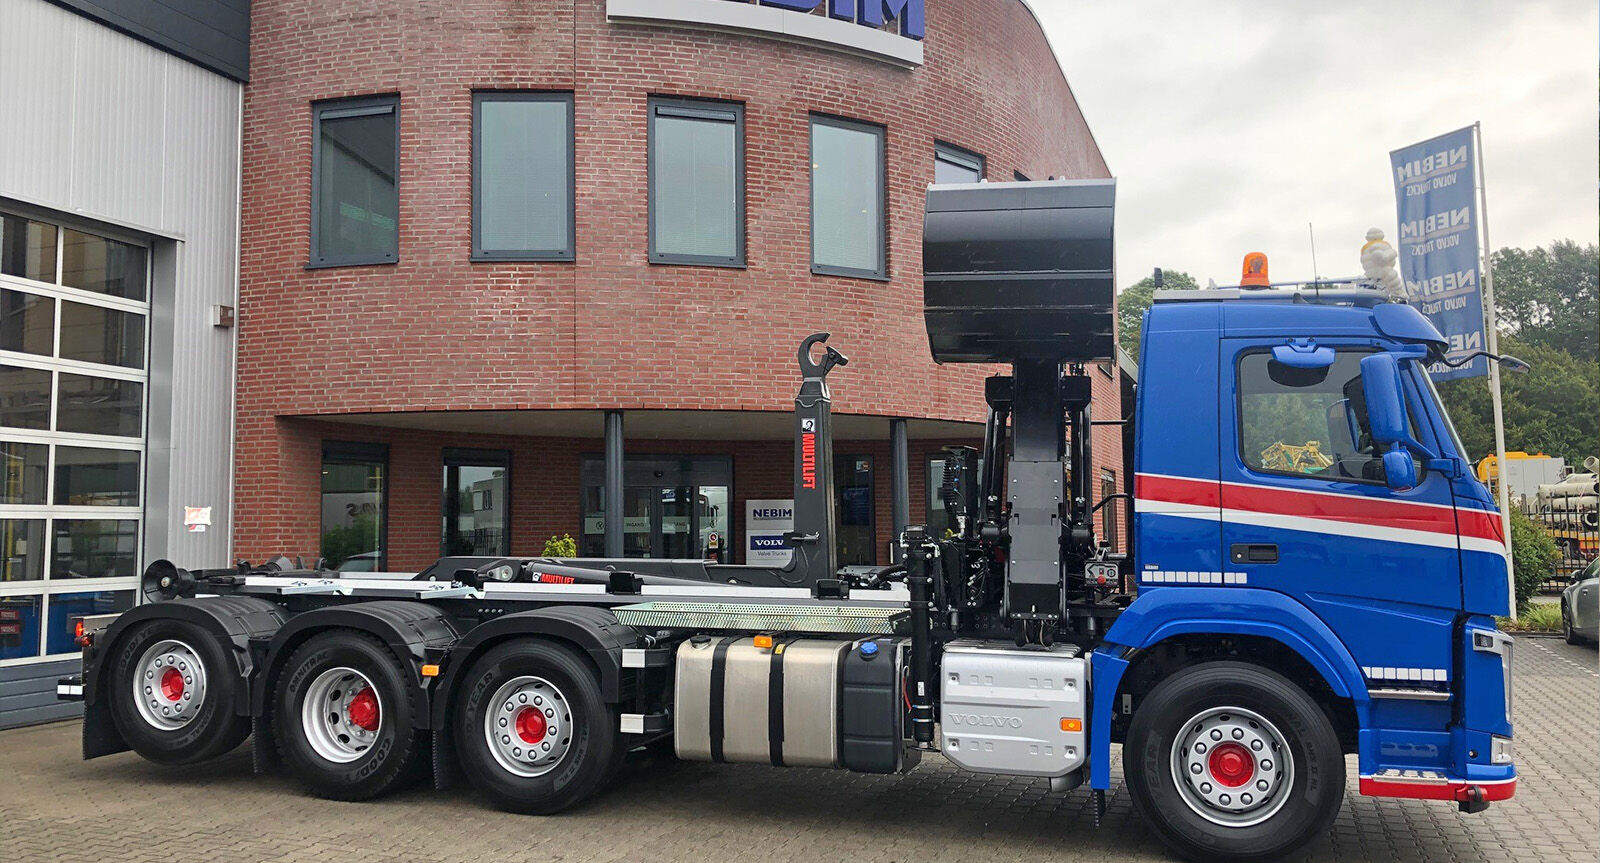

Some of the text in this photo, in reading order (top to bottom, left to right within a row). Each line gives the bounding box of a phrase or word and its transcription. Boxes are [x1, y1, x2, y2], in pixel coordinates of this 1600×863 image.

[802, 433, 815, 489] MULTILIFT
[753, 508, 792, 518] NEBIM
[542, 573, 575, 584] MULTILIFT
[288, 650, 329, 694] OMNITRAC
[948, 712, 1023, 729] VOLVO
